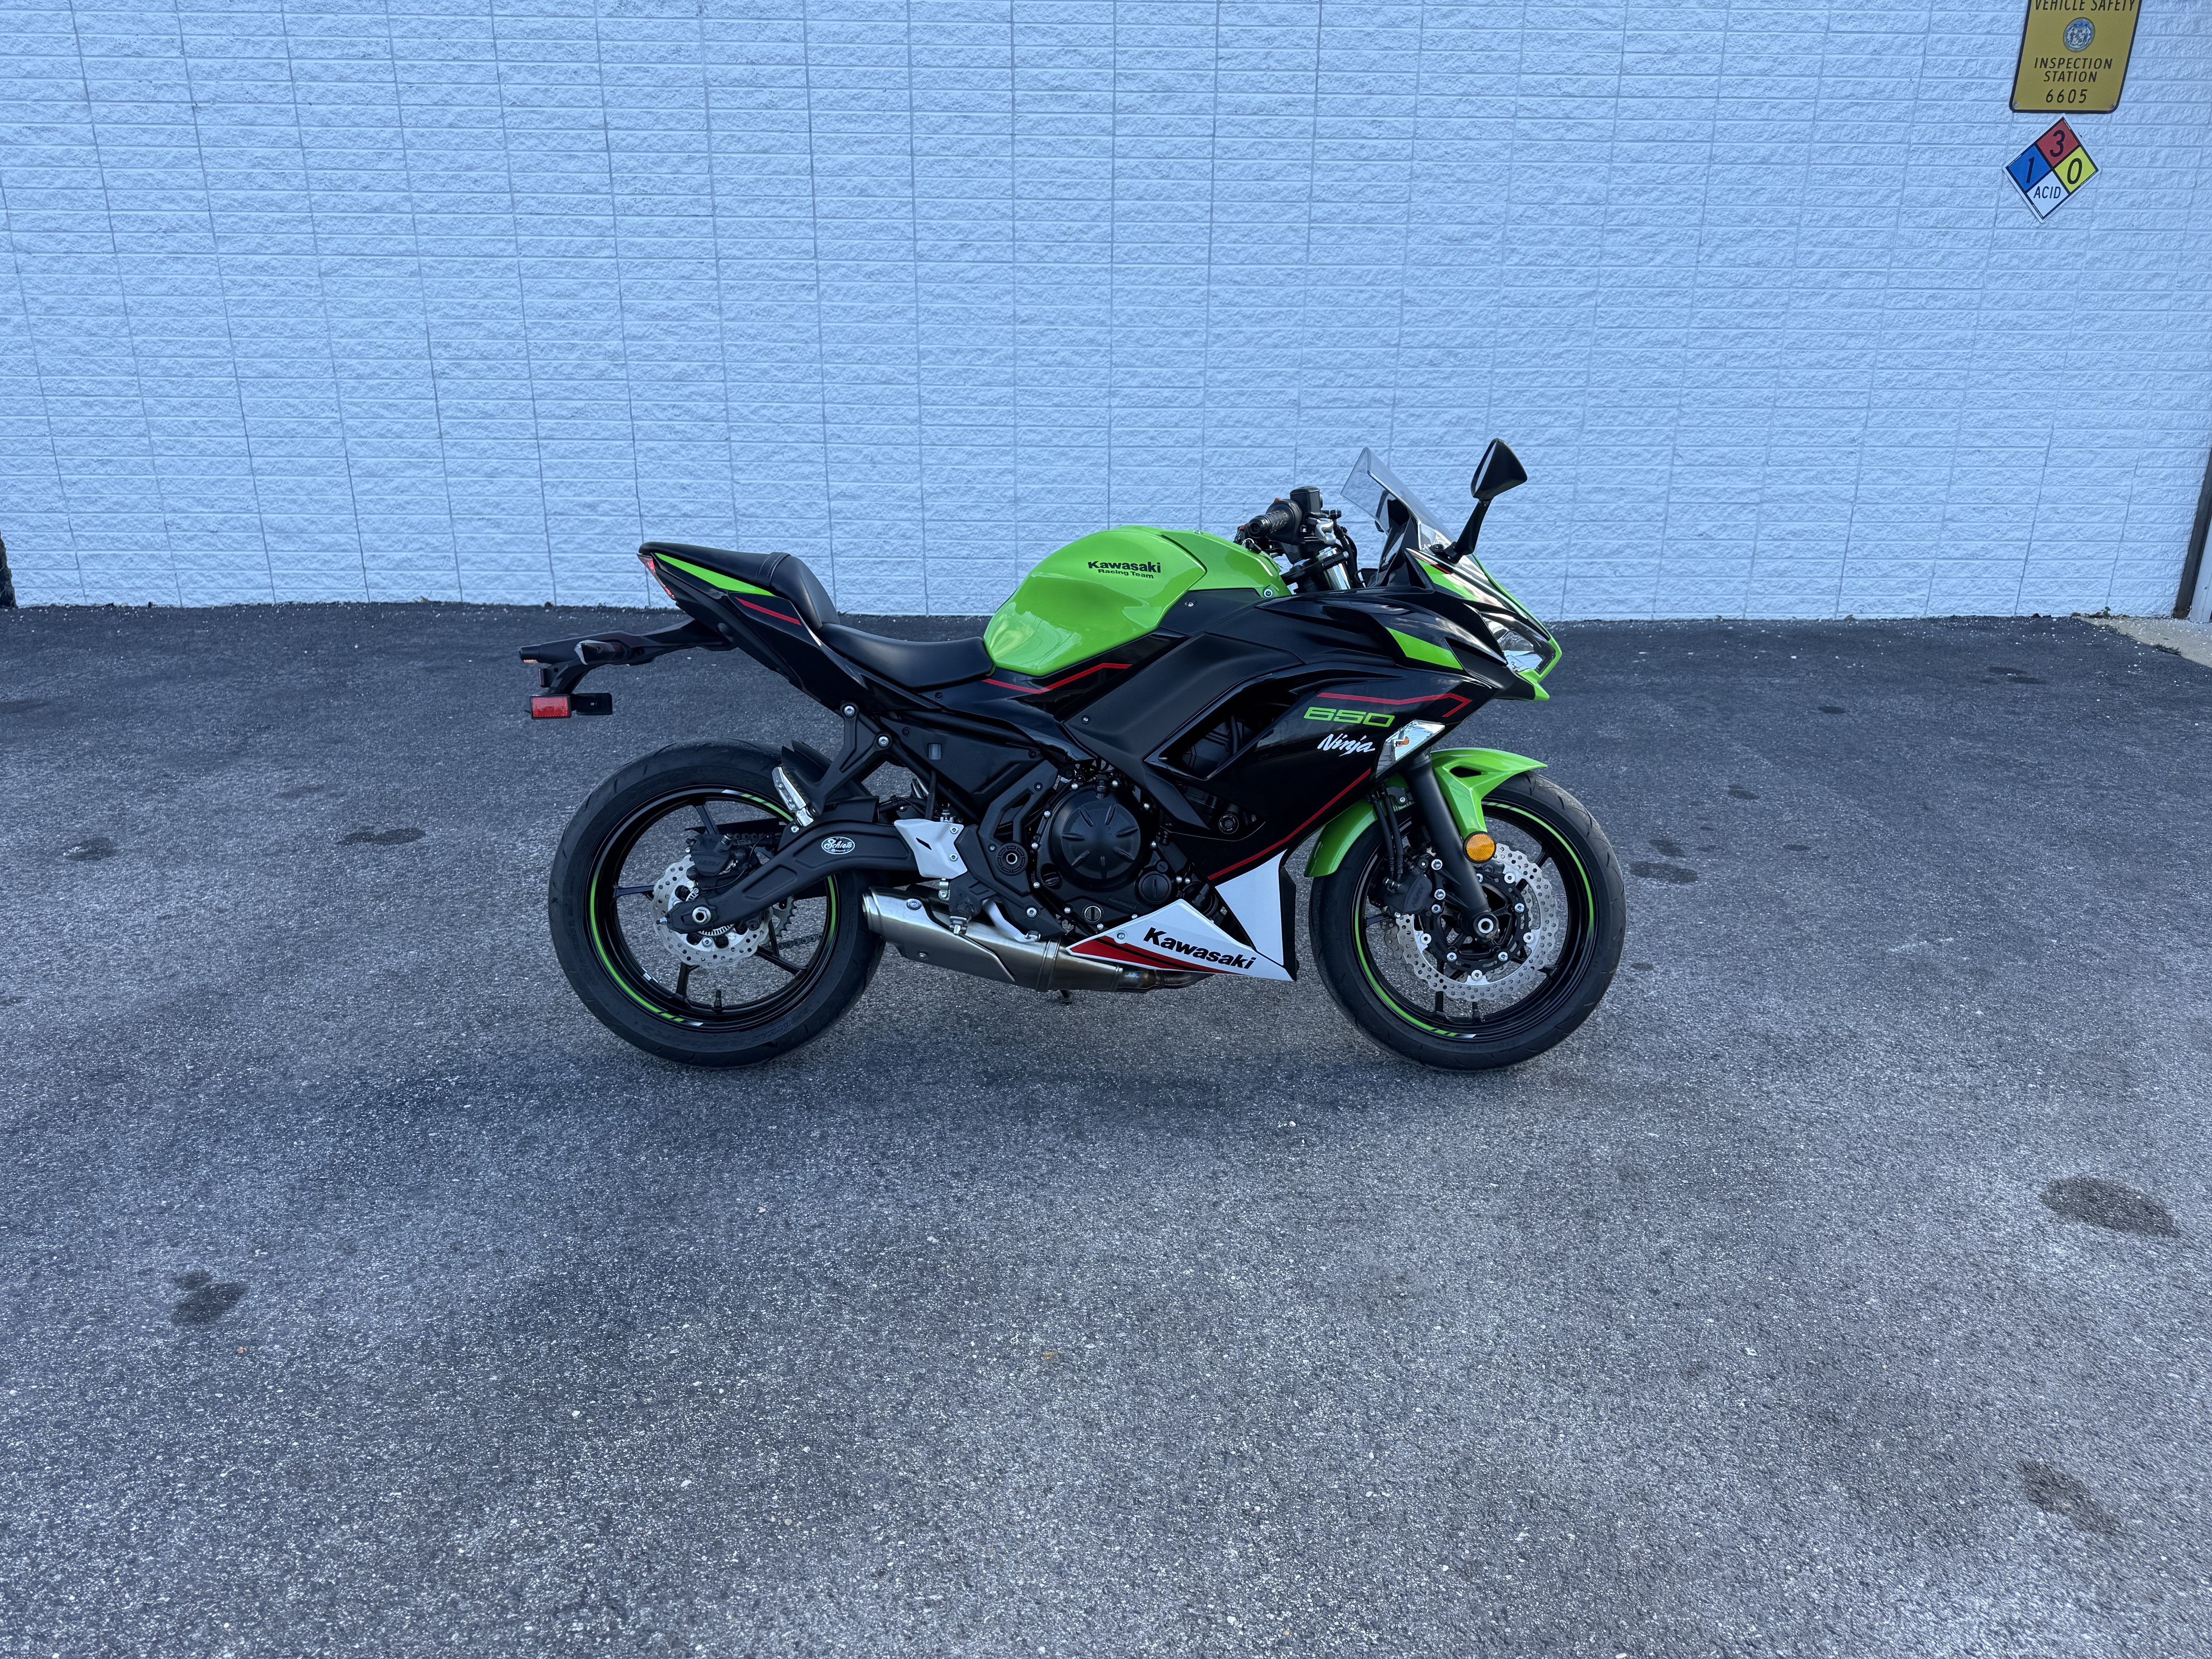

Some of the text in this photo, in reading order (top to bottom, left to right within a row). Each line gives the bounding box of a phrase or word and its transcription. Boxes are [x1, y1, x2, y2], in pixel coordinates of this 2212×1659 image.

[2035, 0, 2135, 11] VEHICLE SAFETY
[2034, 57, 2113, 70] INSPECTION
[2043, 71, 2097, 82] STATION
[2045, 89, 2088, 104] 6605
[2049, 130, 2065, 157] 3
[2026, 156, 2035, 184] 1
[2067, 158, 2083, 185] 0
[2033, 186, 2061, 199] ACID
[1087, 561, 1161, 573] Kawasaki
[1130, 571, 1154, 579] Team
[1304, 706, 1395, 727] 650
[1317, 733, 1375, 757] Ninja
[1143, 927, 1257, 969] Kawasaki
